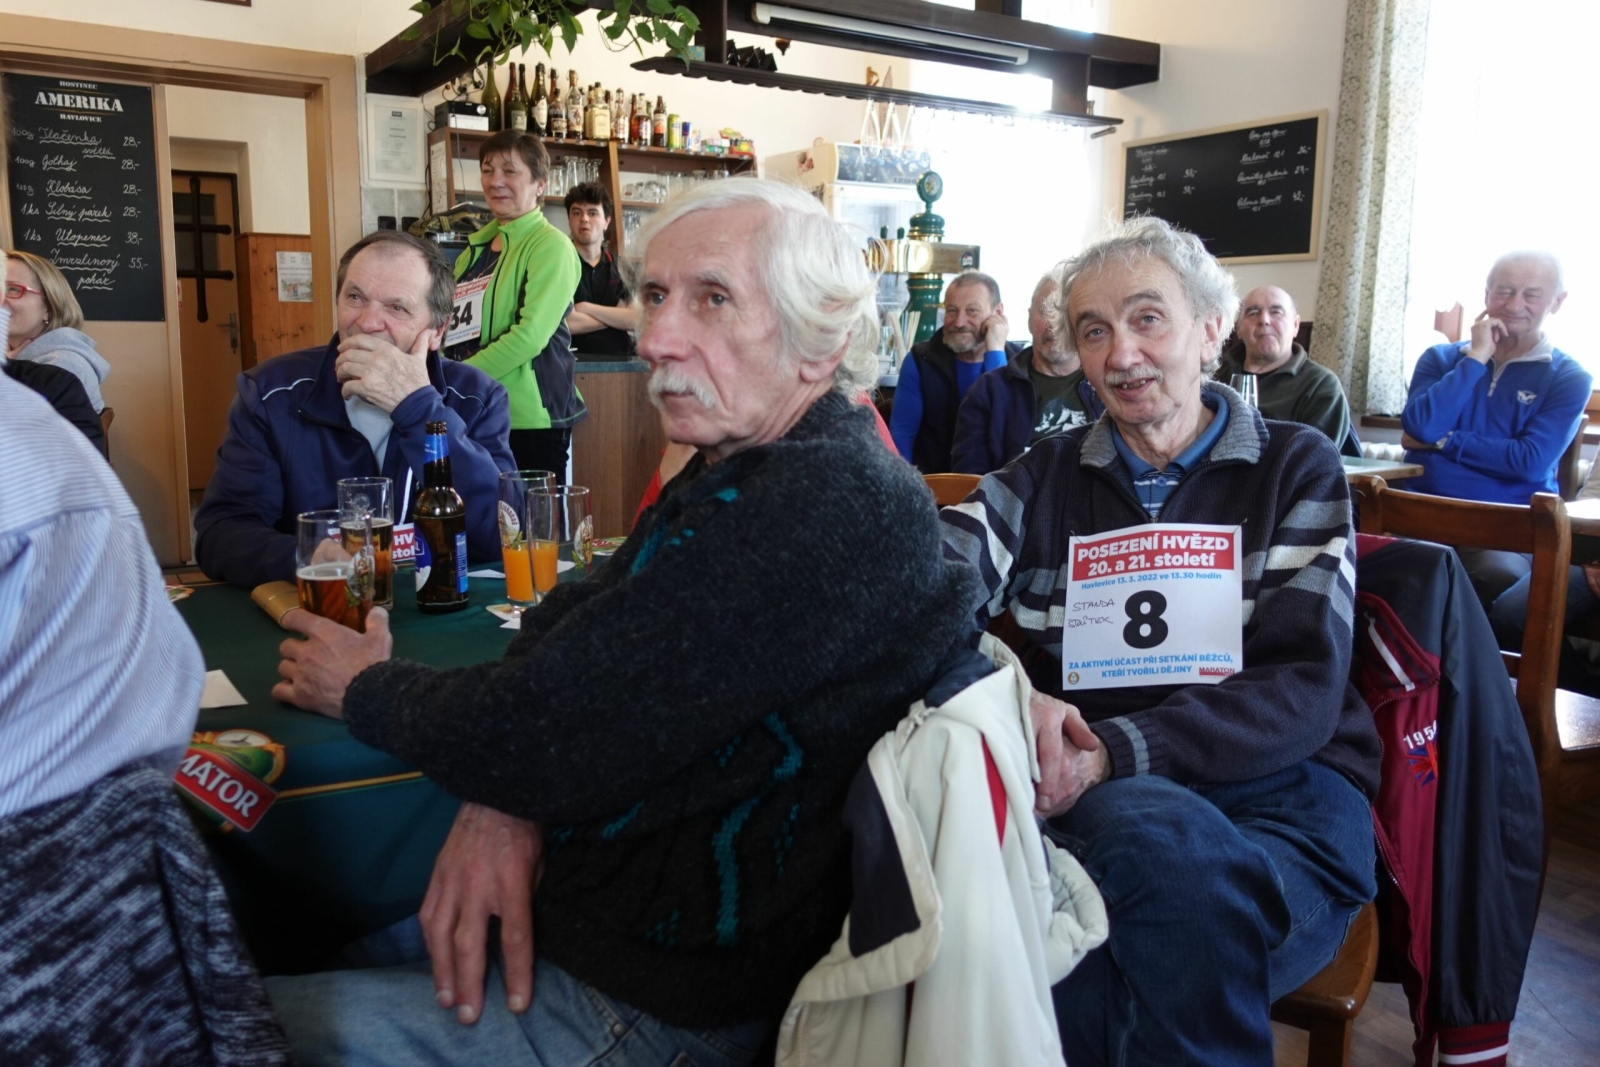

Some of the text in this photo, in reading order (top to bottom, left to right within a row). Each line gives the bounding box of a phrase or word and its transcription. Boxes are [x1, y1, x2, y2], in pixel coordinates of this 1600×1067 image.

[59, 80, 98, 90] HOSTINEC
[34, 91, 124, 112] AMERIKA
[60, 113, 102, 122] HAVLOVICE
[15, 155, 36, 168] 100g
[42, 154, 78, 171] Gothaj
[46, 180, 93, 194] Klobása
[78, 205, 112, 221] párek
[55, 228, 112, 247] Utopenec
[76, 273, 116, 290] pohár
[449, 300, 473, 331] 34
[393, 532, 415, 546] HV
[1077, 532, 1230, 562] POSEZENÍ HVĚZD
[392, 545, 415, 559] stol
[1088, 552, 1216, 577] 20. a 21. století
[1081, 577, 1116, 590] Havlovice
[1117, 576, 1128, 585] 13.
[1129, 575, 1136, 583] 3.
[1137, 573, 1158, 581] 2022
[1171, 571, 1194, 579] 13.30
[1196, 571, 1222, 580] hodin
[1072, 598, 1115, 612] STANDA
[1122, 589, 1169, 650] 8
[1068, 651, 1233, 670] ZA AKTIVNÍ ÚČAST PŘI SETKÁNÍ BĚŽCŮ,
[1101, 664, 1235, 678] KTEŘÍ TVOŘILI DĚJINY MARATON
